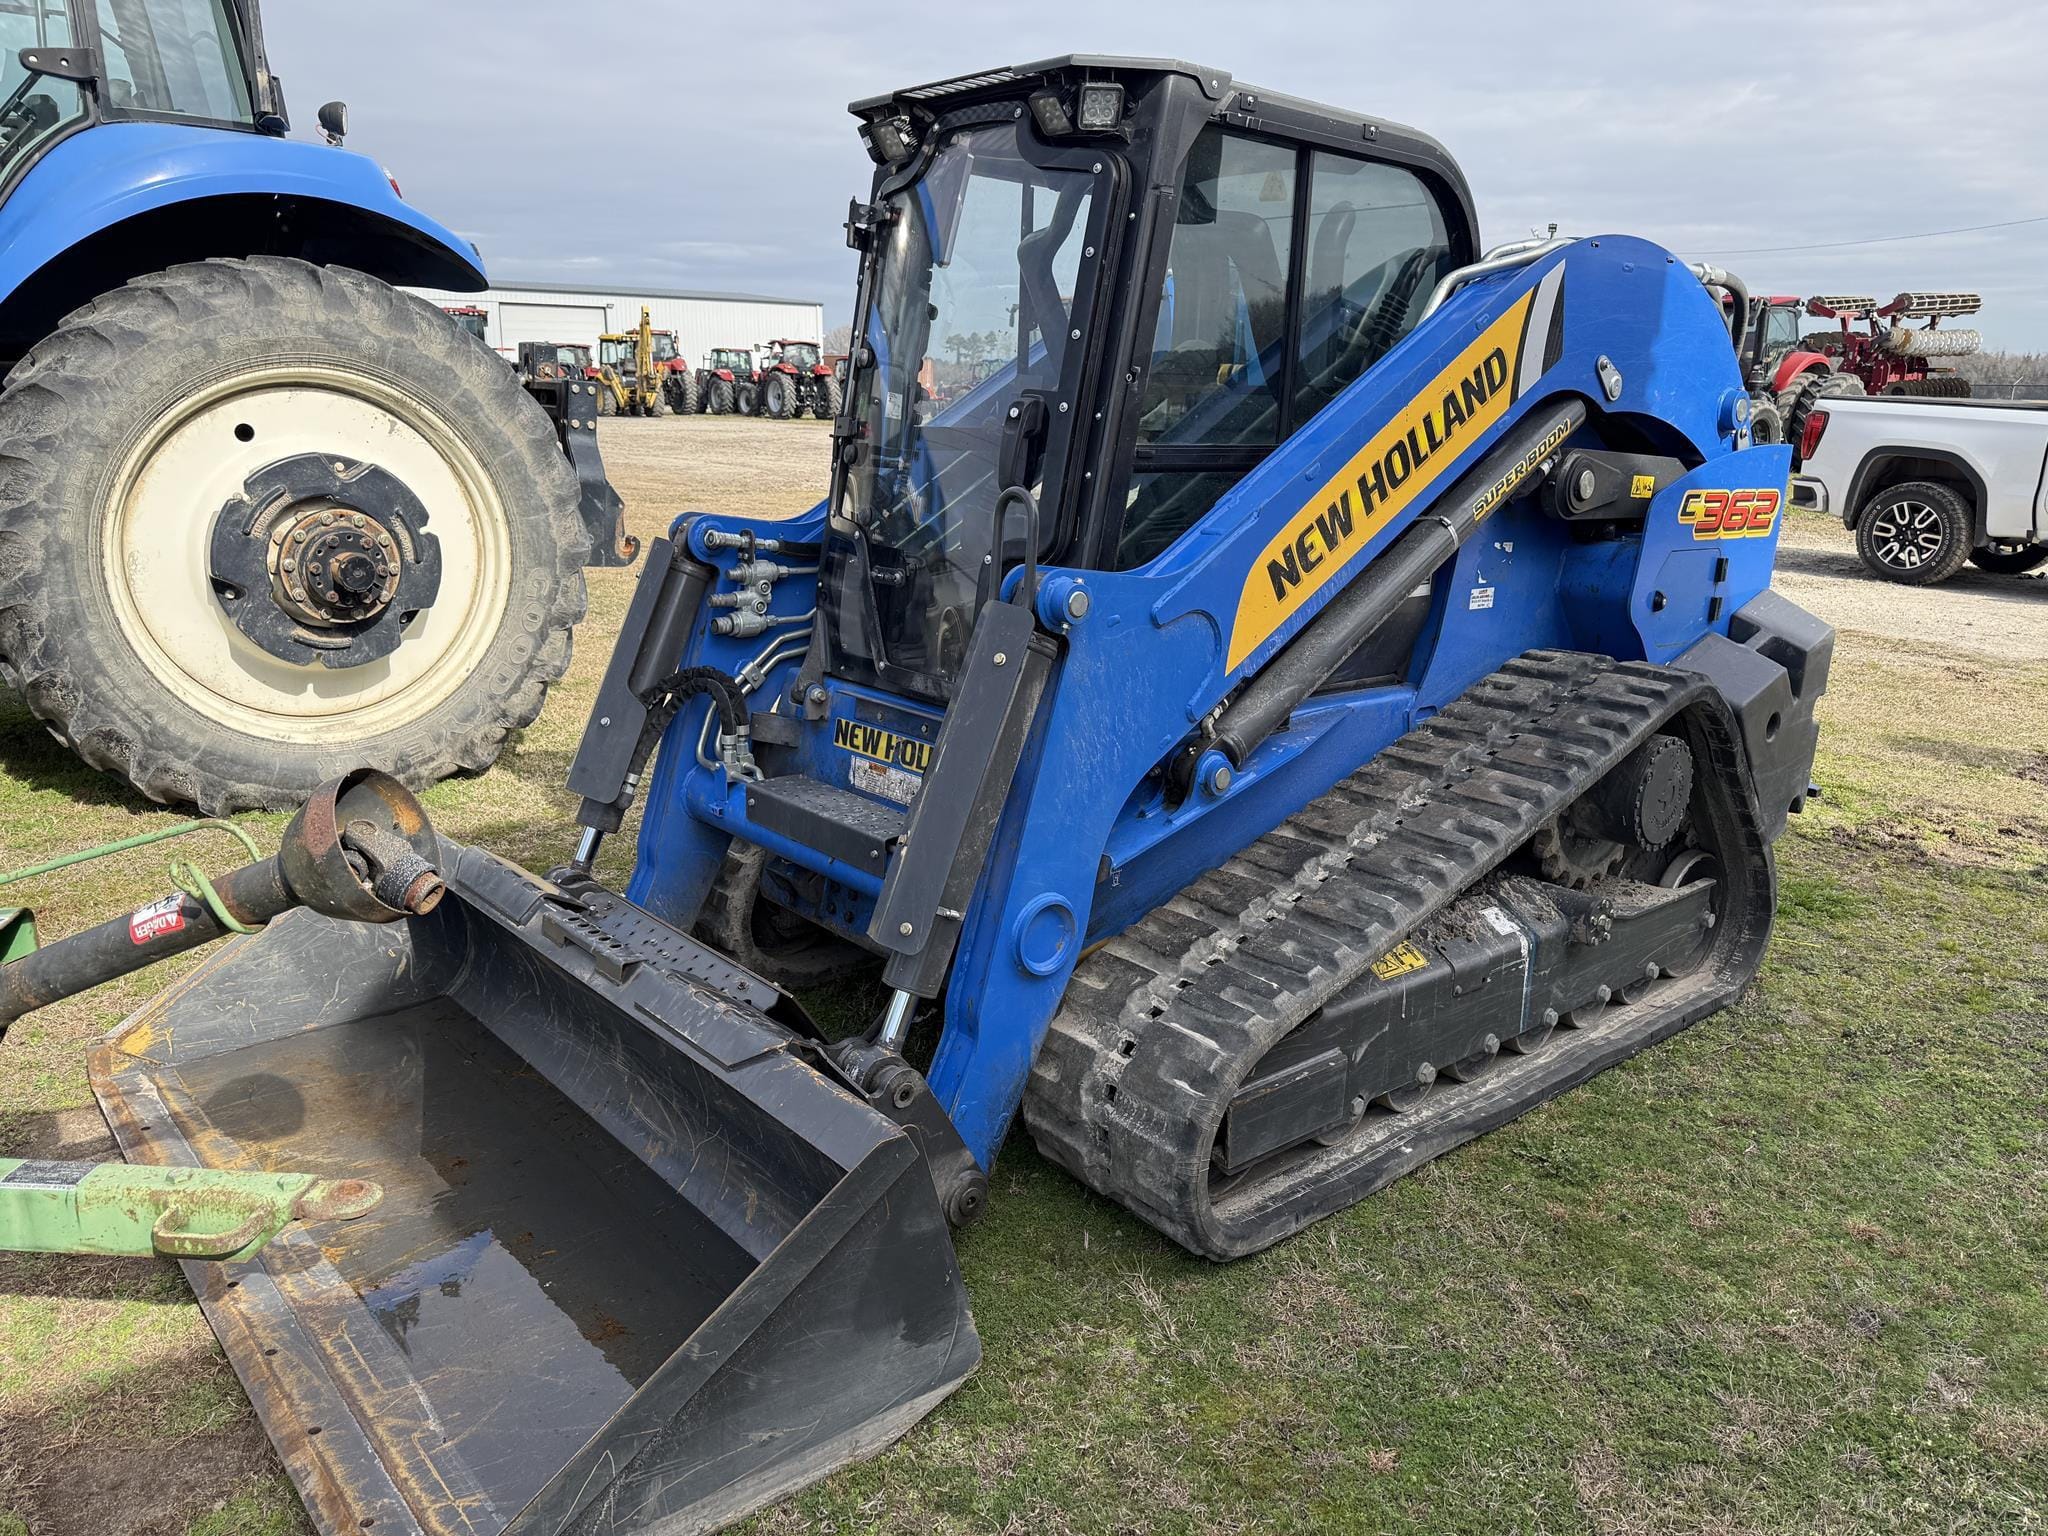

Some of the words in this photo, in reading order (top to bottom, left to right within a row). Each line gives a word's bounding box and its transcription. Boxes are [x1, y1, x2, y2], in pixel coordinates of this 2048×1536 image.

[1266, 488, 1357, 604] NEW
[1356, 346, 1510, 518] HOLLAND
[1472, 461, 1529, 521] SUPER
[1526, 418, 1571, 472] BOOM
[1678, 488, 1781, 540] C362
[317, 566, 550, 783] GOODYEAR
[834, 718, 882, 756] NEW
[884, 732, 935, 771] HOL
